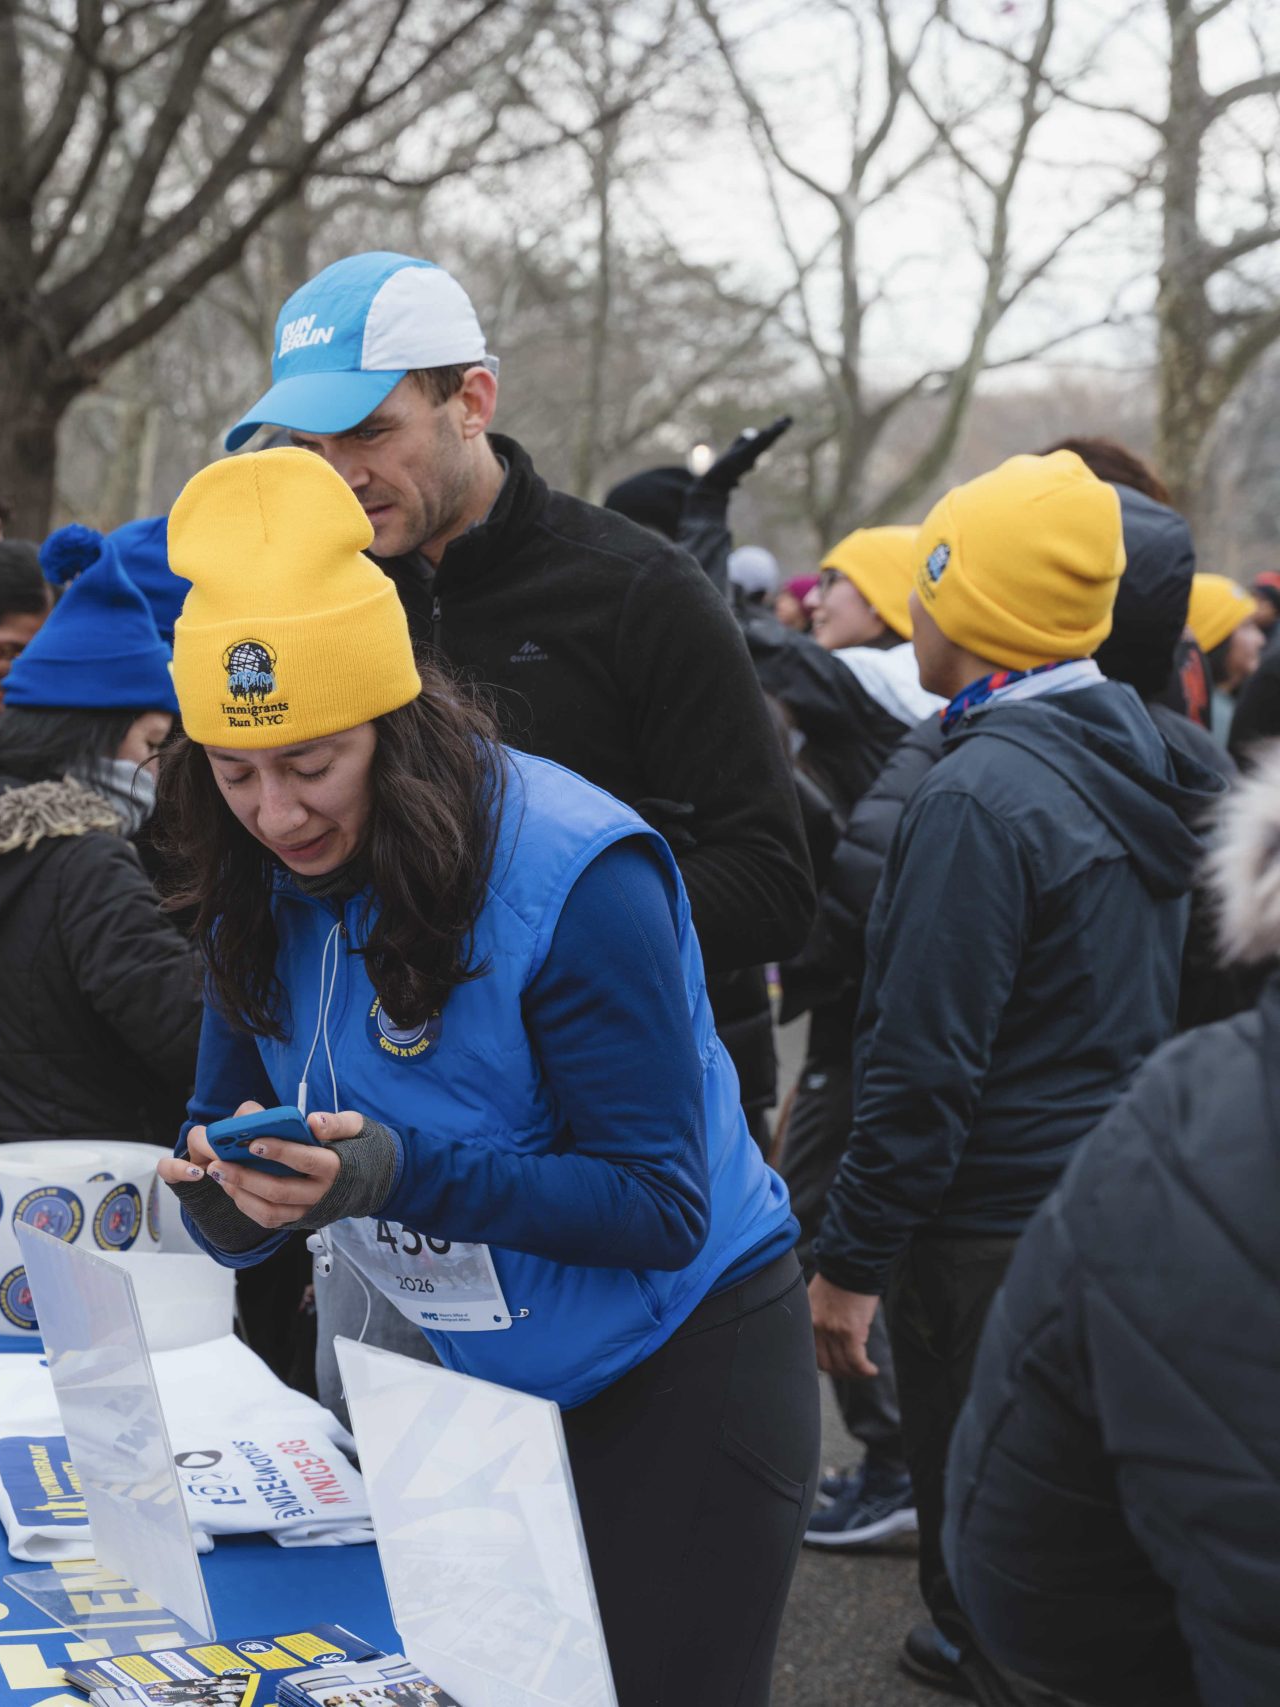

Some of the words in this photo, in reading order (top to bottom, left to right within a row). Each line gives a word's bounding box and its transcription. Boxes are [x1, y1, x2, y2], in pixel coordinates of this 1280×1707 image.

[283, 314, 317, 338] RUN
[278, 326, 335, 359] BERLIN
[222, 702, 289, 716] Immigrants
[228, 716, 251, 727] Run
[254, 714, 284, 726] NYC
[379, 1037, 399, 1056] QDR
[400, 1048, 408, 1057] X
[408, 1037, 430, 1057] NICE
[396, 1276, 435, 1293] 2026
[420, 1311, 439, 1320] NYC
